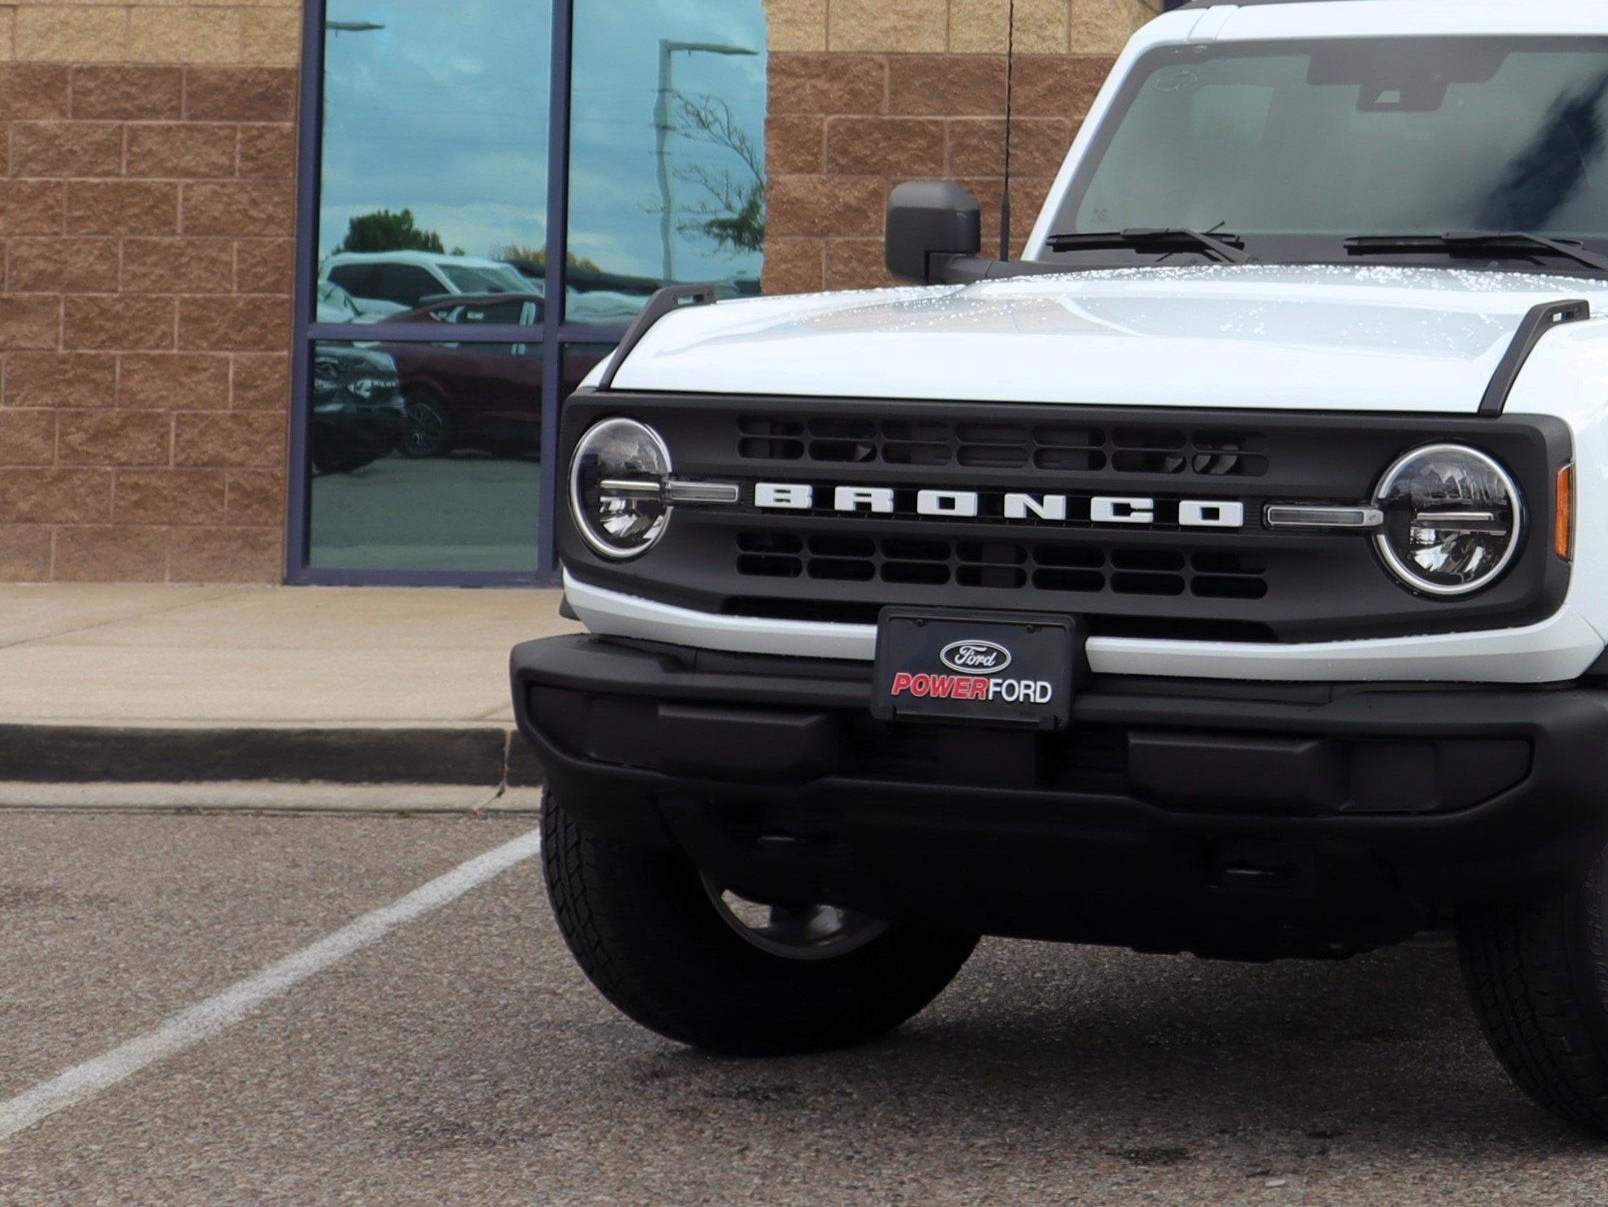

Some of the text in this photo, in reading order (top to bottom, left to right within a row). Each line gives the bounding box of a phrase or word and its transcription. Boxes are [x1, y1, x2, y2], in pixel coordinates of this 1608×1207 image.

[754, 482, 1244, 528] BRONCO
[954, 645, 997, 667] Ford
[891, 672, 1053, 704] POWERFORD
